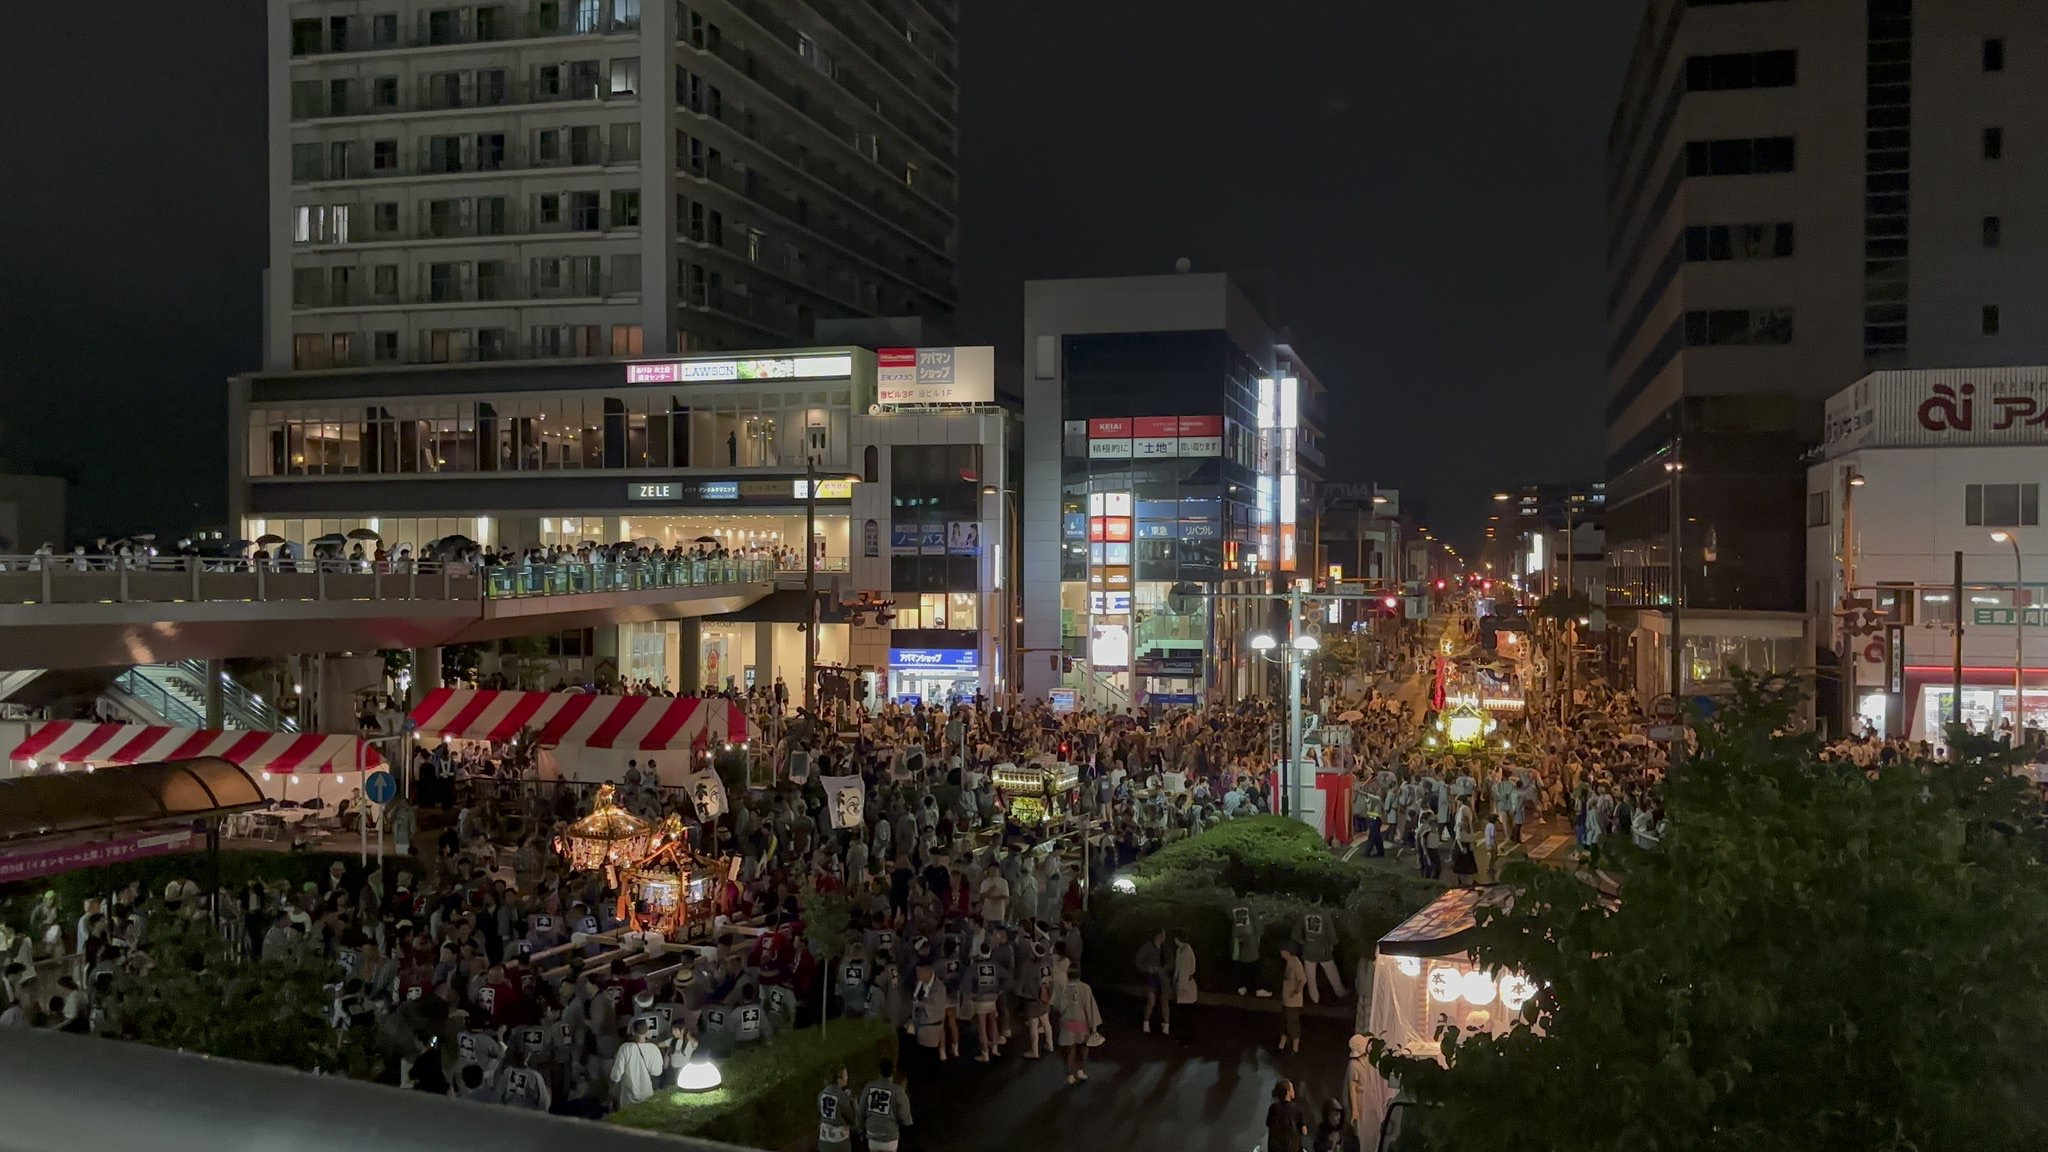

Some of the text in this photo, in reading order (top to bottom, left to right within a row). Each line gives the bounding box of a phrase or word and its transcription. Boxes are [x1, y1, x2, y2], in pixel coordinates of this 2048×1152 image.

[920, 352, 951, 364] アパマン
[685, 366, 734, 377] LAWSON
[920, 366, 951, 379] ショップ
[1092, 443, 1129, 454] 積極的に
[640, 486, 670, 497] ZELE
[1151, 526, 1213, 536] 東急 リバブル
